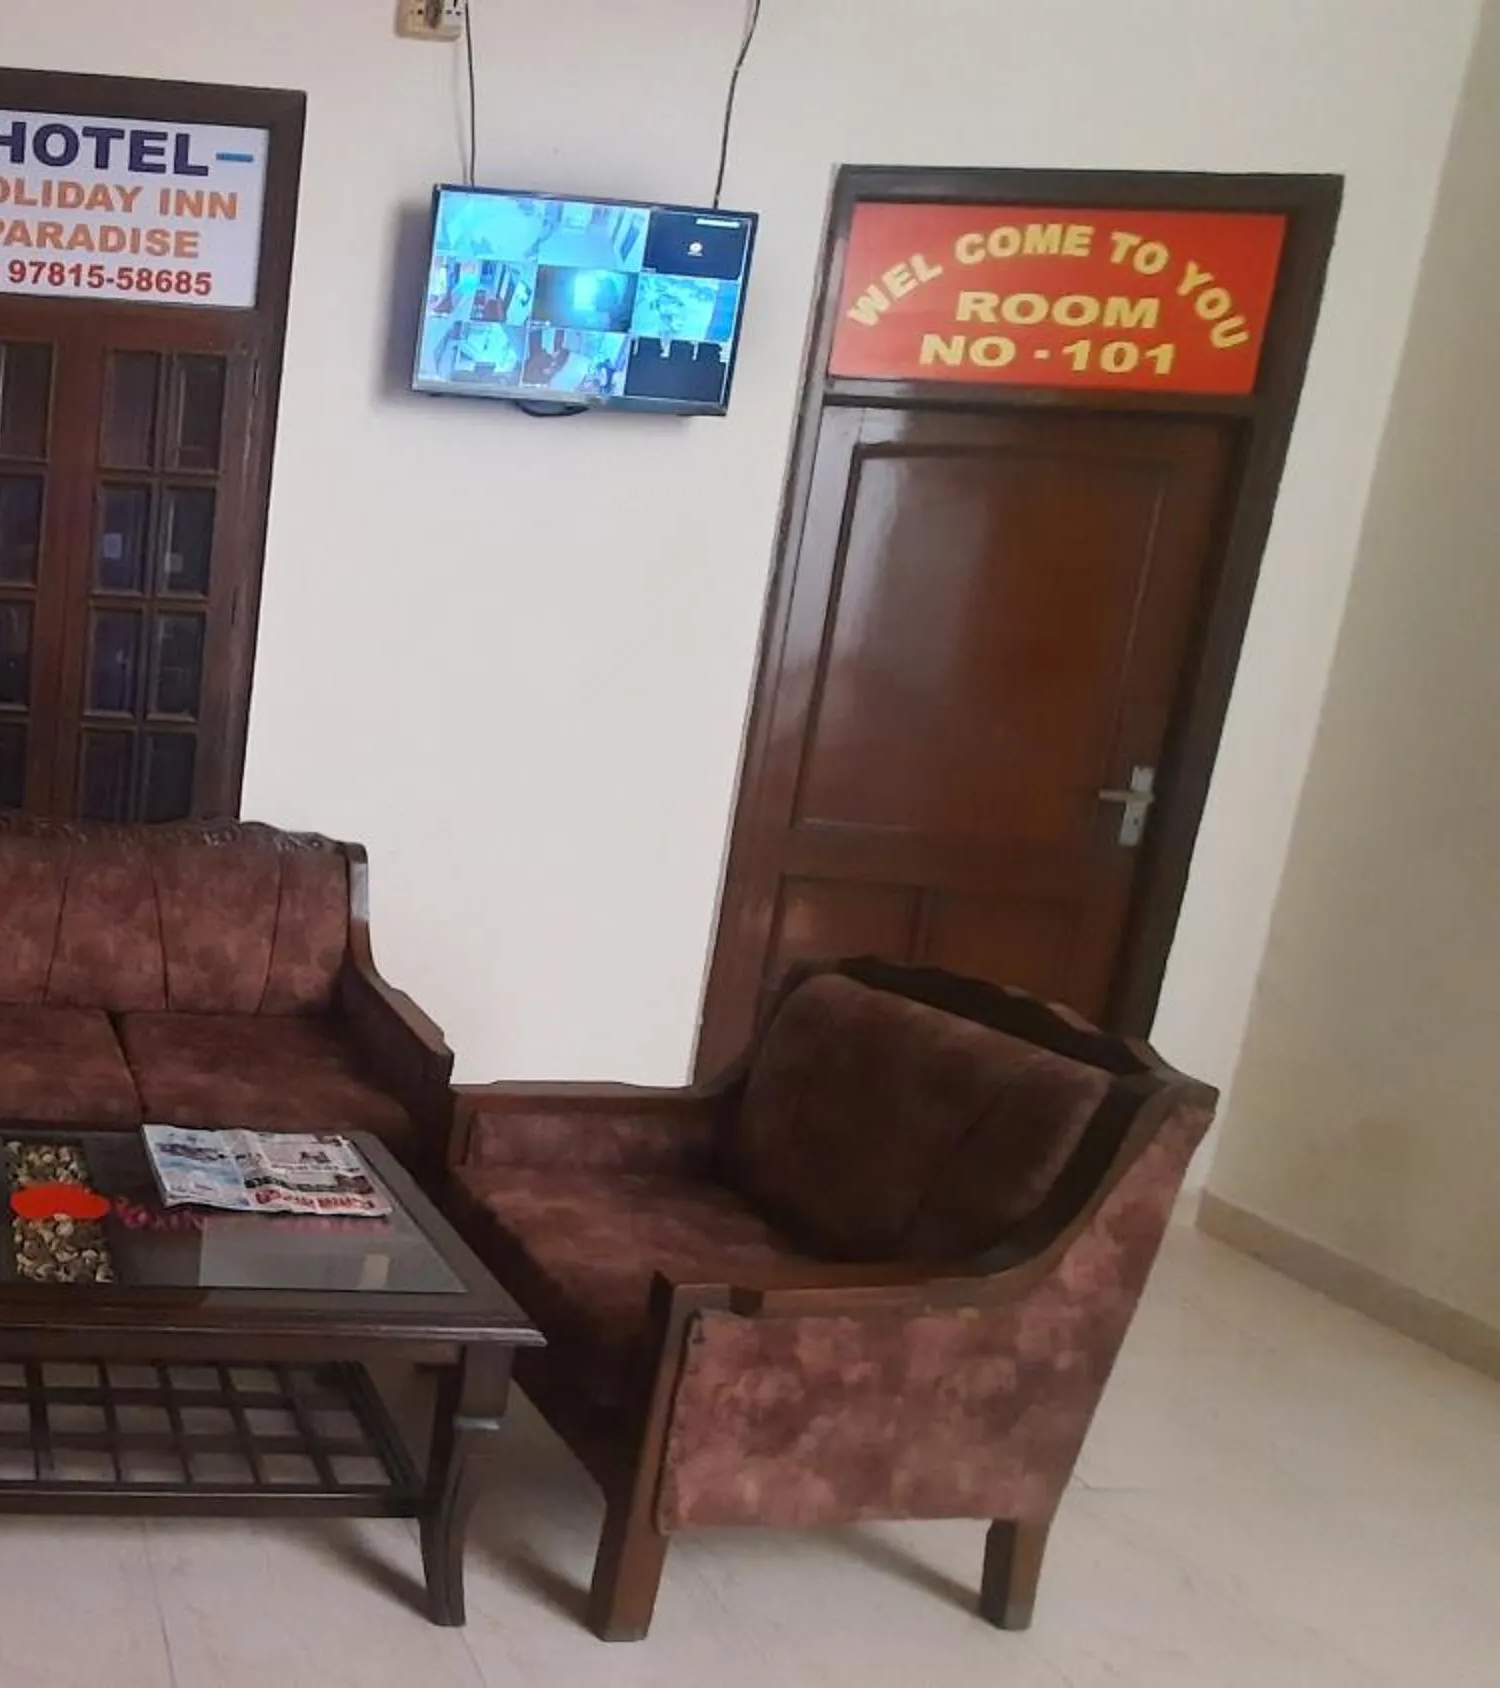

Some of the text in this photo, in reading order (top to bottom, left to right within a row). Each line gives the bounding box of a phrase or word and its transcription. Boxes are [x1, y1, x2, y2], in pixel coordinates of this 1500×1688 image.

[159, 188, 238, 220] INN
[8, 259, 213, 296] 97815-58685
[847, 223, 1250, 349] WEL COME TO YOU
[956, 291, 1161, 329] ROOM
[919, 334, 1017, 367] NO
